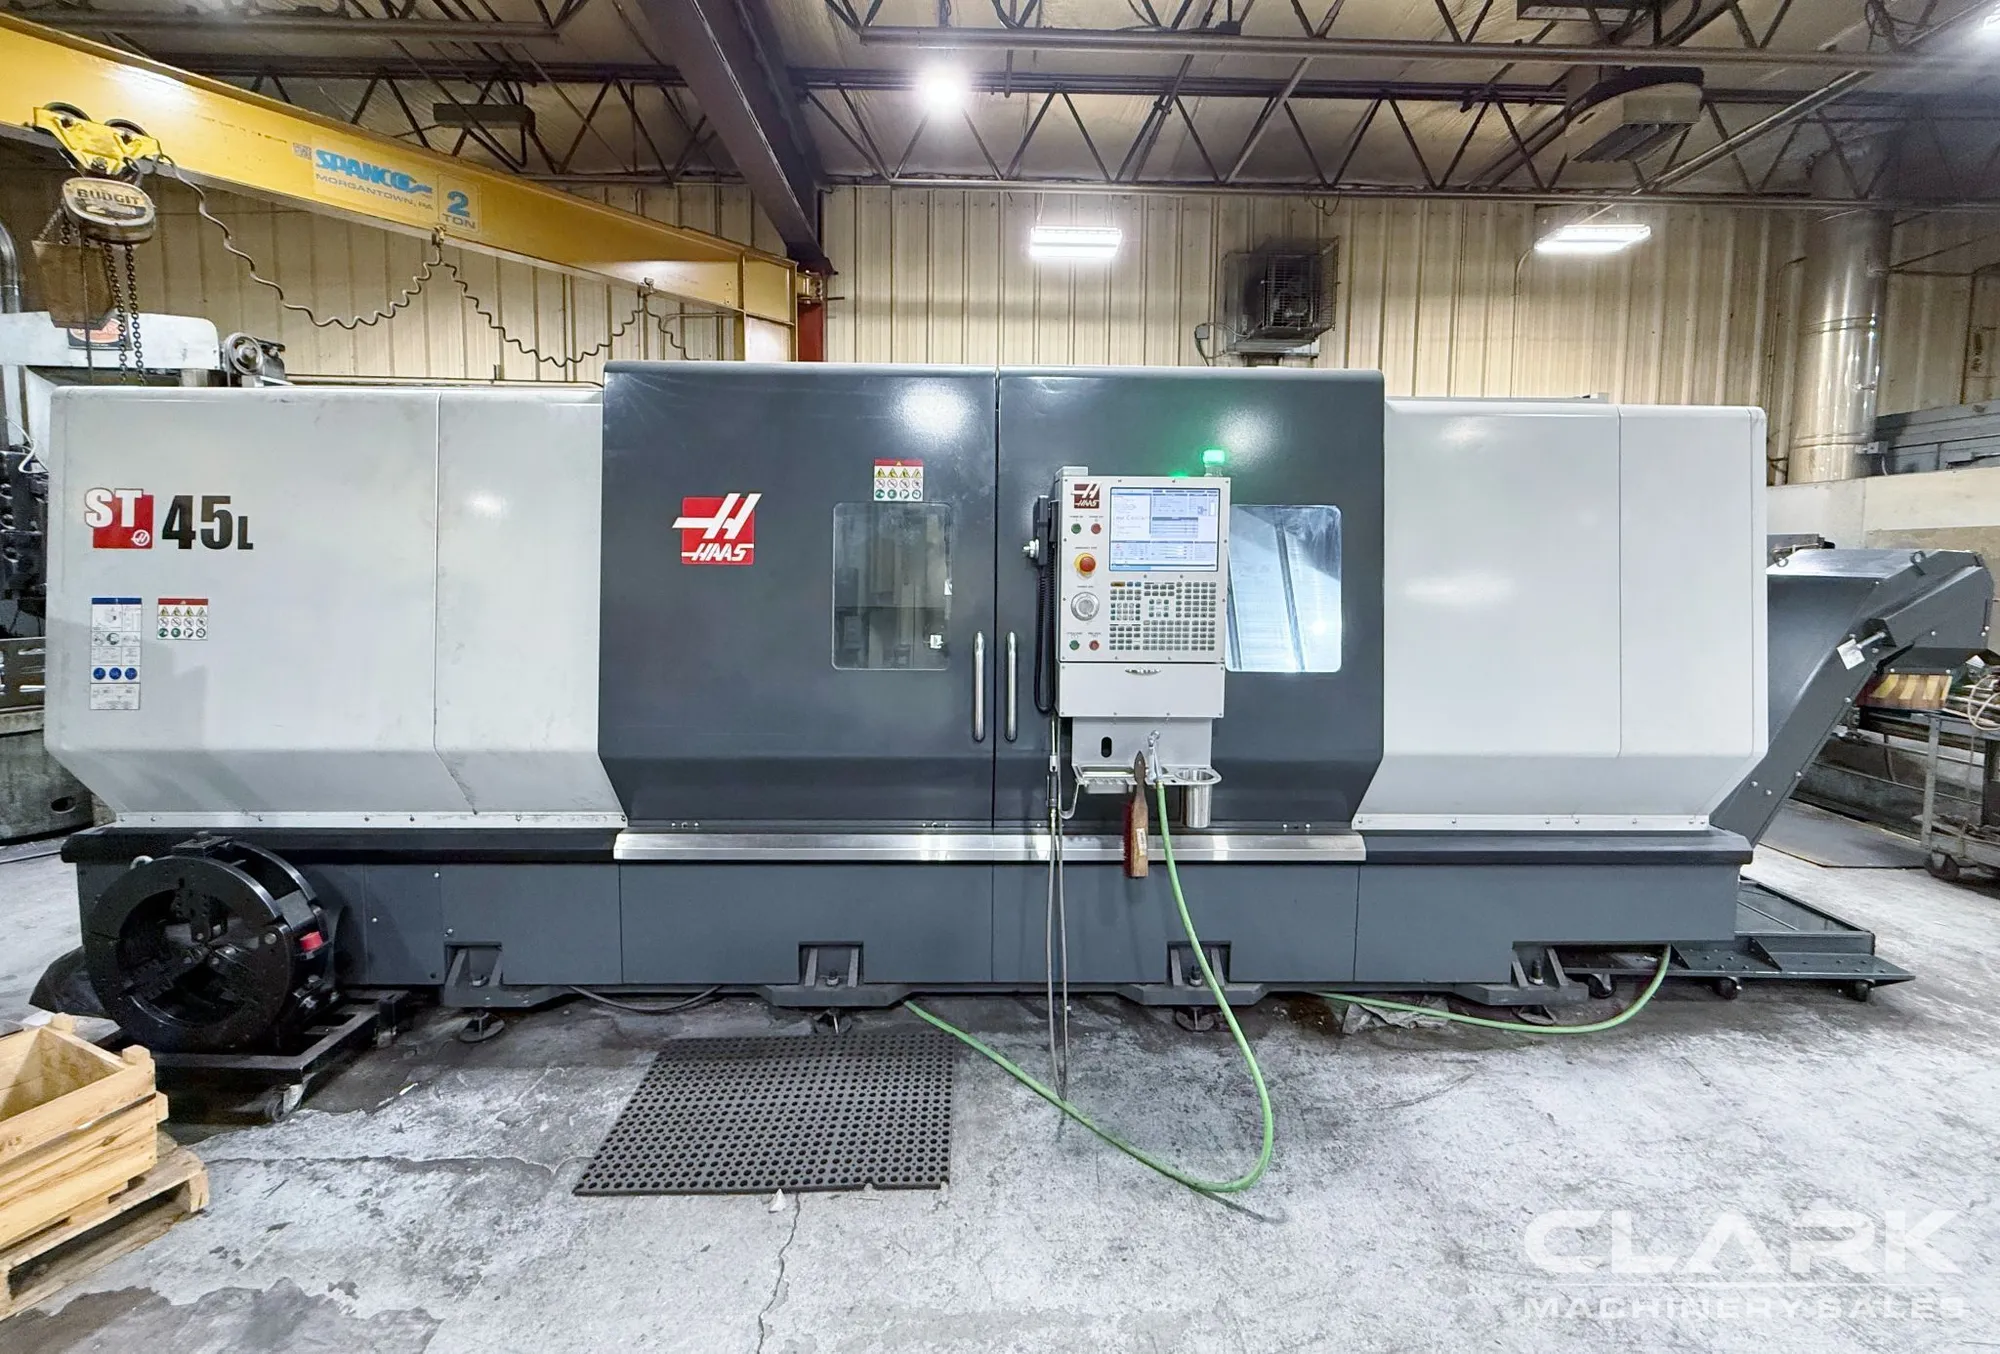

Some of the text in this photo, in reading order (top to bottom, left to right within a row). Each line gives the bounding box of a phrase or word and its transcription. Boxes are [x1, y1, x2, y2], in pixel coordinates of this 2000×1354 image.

[315, 150, 426, 193] SPANCO
[76, 188, 141, 205] BUDGIT
[447, 190, 470, 217] 2
[442, 213, 476, 229] TON
[84, 487, 144, 528] ST
[681, 542, 755, 562] HAAS
